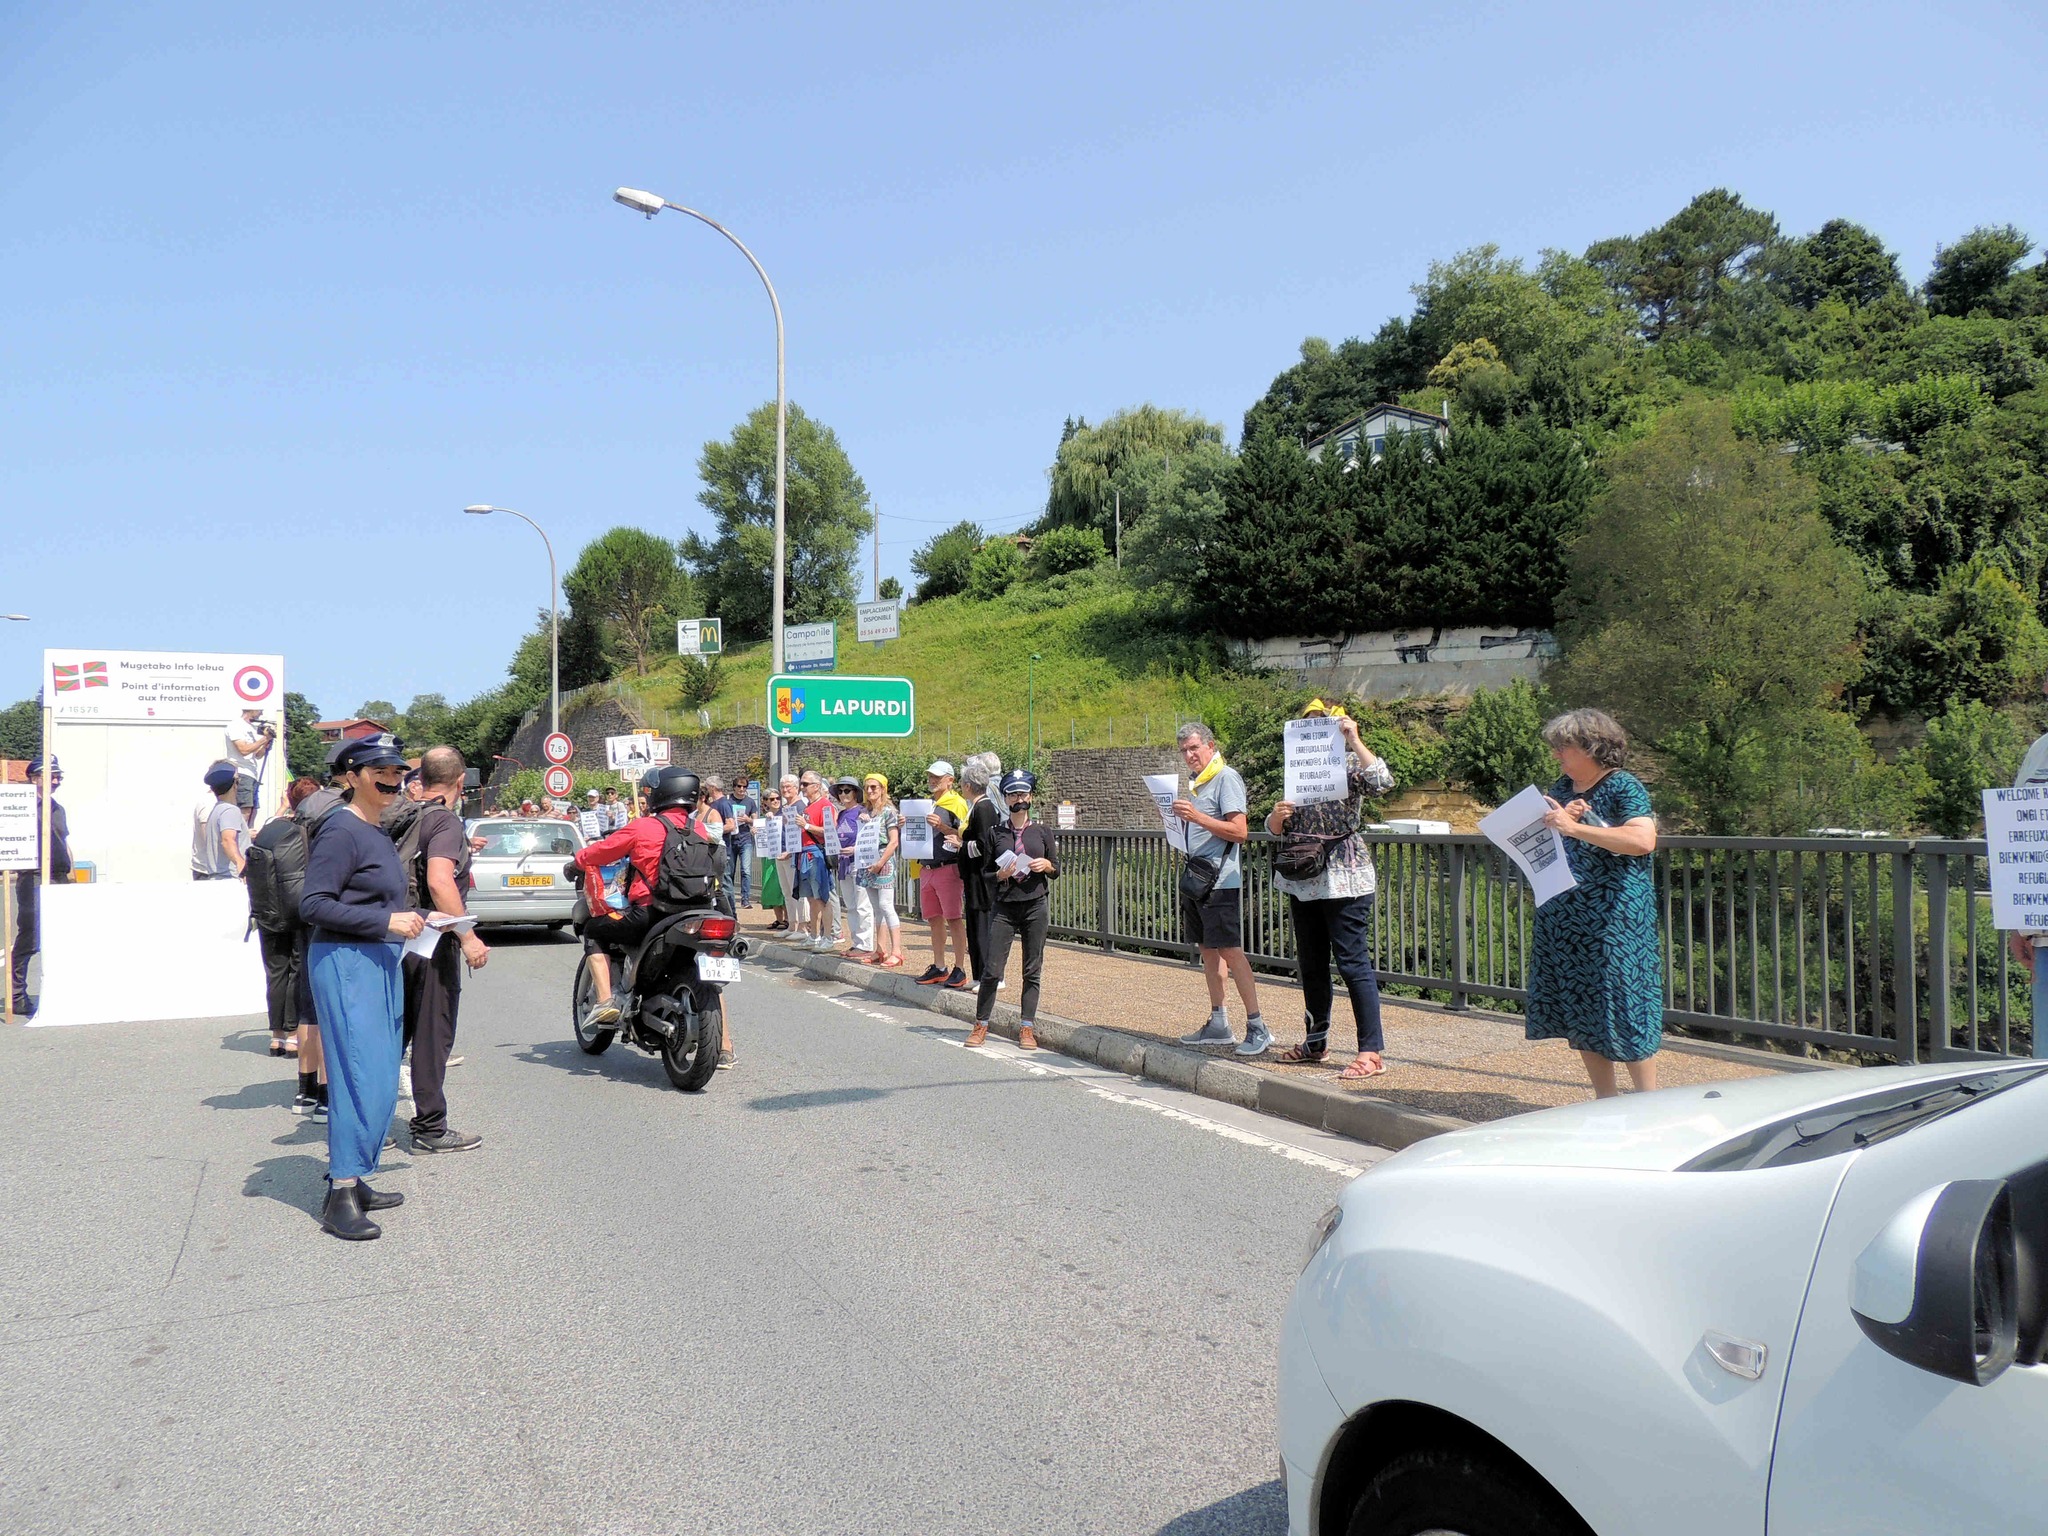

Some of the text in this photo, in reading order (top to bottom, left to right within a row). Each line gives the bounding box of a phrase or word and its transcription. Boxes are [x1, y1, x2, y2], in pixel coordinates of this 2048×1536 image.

[860, 606, 895, 615] EMPLACEMENT
[864, 614, 892, 623] DISPONIBLE
[786, 627, 831, 640] Campanile
[120, 661, 171, 671] Mugetako
[174, 663, 194, 671] Info
[121, 682, 220, 692] Point d'information
[160, 694, 206, 702] frontières
[821, 699, 907, 716] LAPURDI
[1291, 718, 1336, 728] WELCOME REFUGEES
[1300, 731, 1328, 741] ONGI ETORRI
[1296, 744, 1334, 754] ERREFUXIATUAK
[1323, 757, 1327, 765] A
[1328, 756, 1340, 766] L@S
[1299, 770, 1331, 780] REFUGIAD@S
[1296, 783, 1335, 793] BIENVENUE AUX
[1997, 788, 2040, 801] WELCOME
[2016, 809, 2037, 822] ONGI
[1512, 831, 1529, 845] inor
[1535, 834, 1545, 843] ez
[1534, 848, 1544, 857] da
[510, 877, 530, 885] 3463
